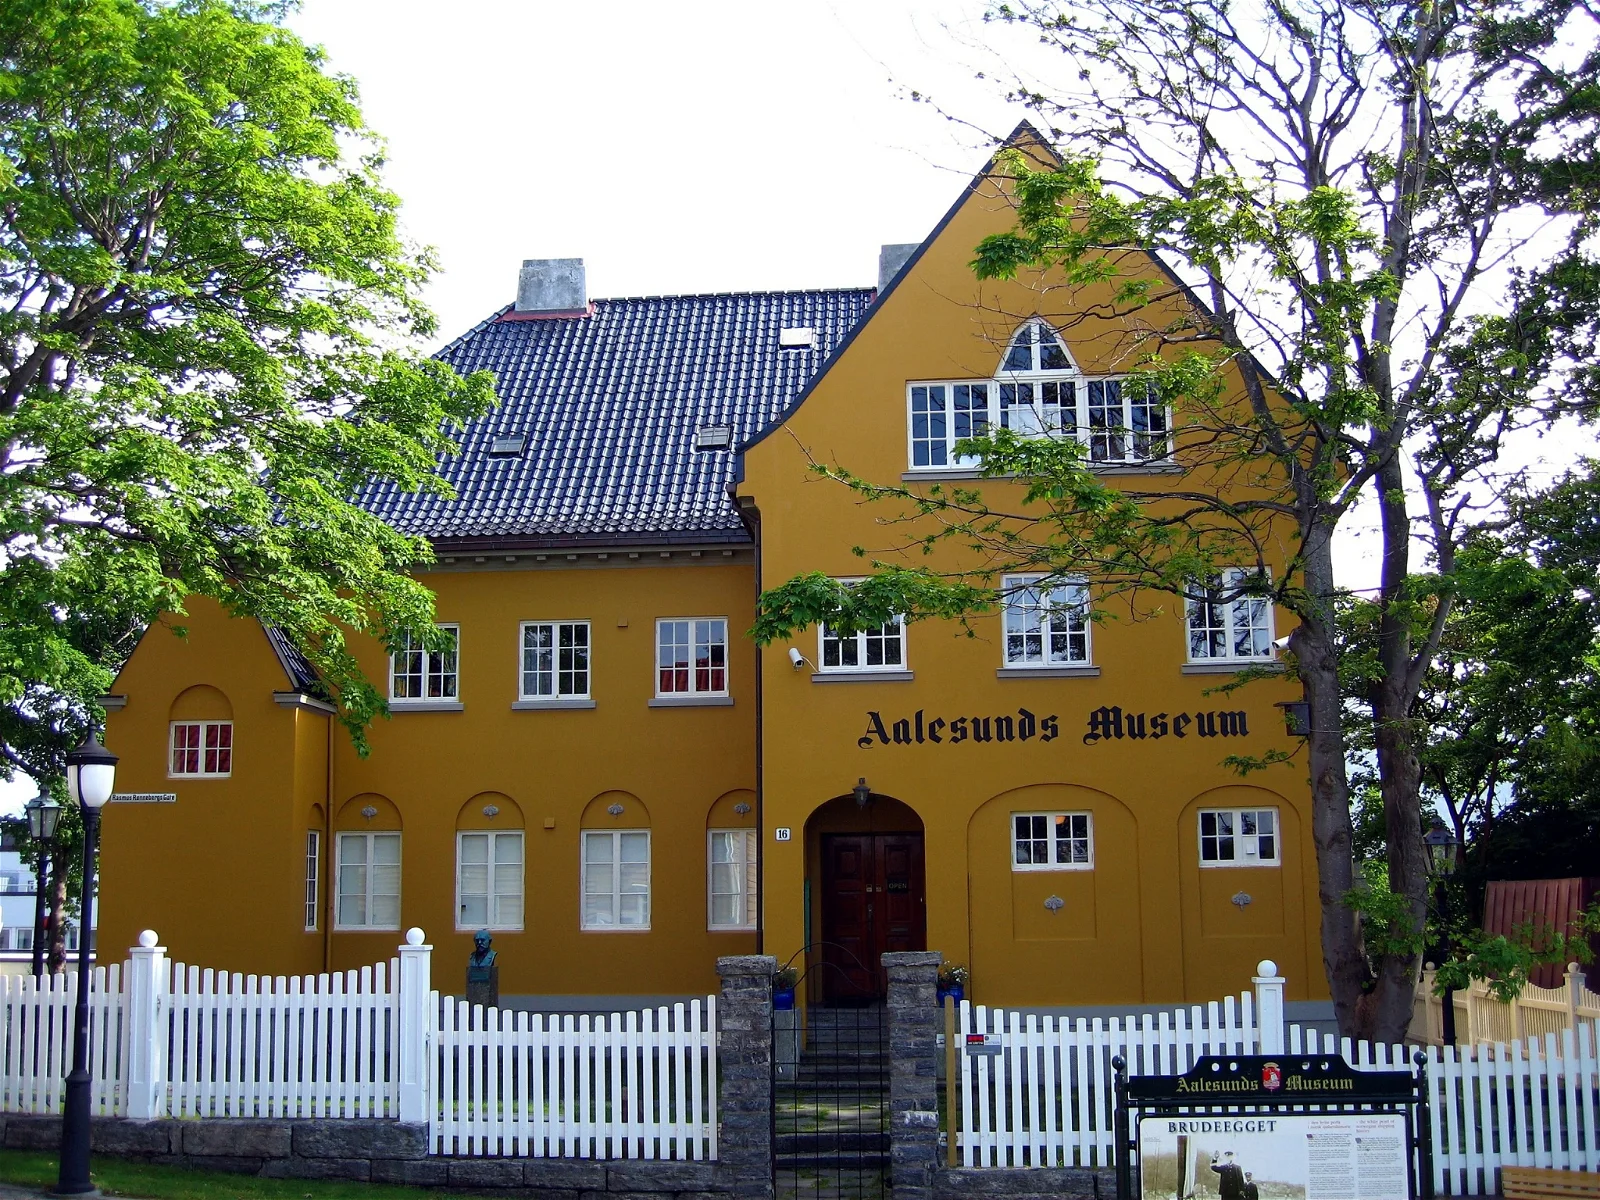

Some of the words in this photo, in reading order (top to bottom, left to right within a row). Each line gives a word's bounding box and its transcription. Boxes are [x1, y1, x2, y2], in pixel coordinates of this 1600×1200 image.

[857, 707, 1059, 750] Aalesunds
[1082, 705, 1250, 746] Museum
[777, 829, 788, 839] 16
[1175, 1076, 1259, 1093] Aalesunds
[1285, 1075, 1354, 1091] Museum
[1167, 1119, 1277, 1134] BRUDEEGGET
